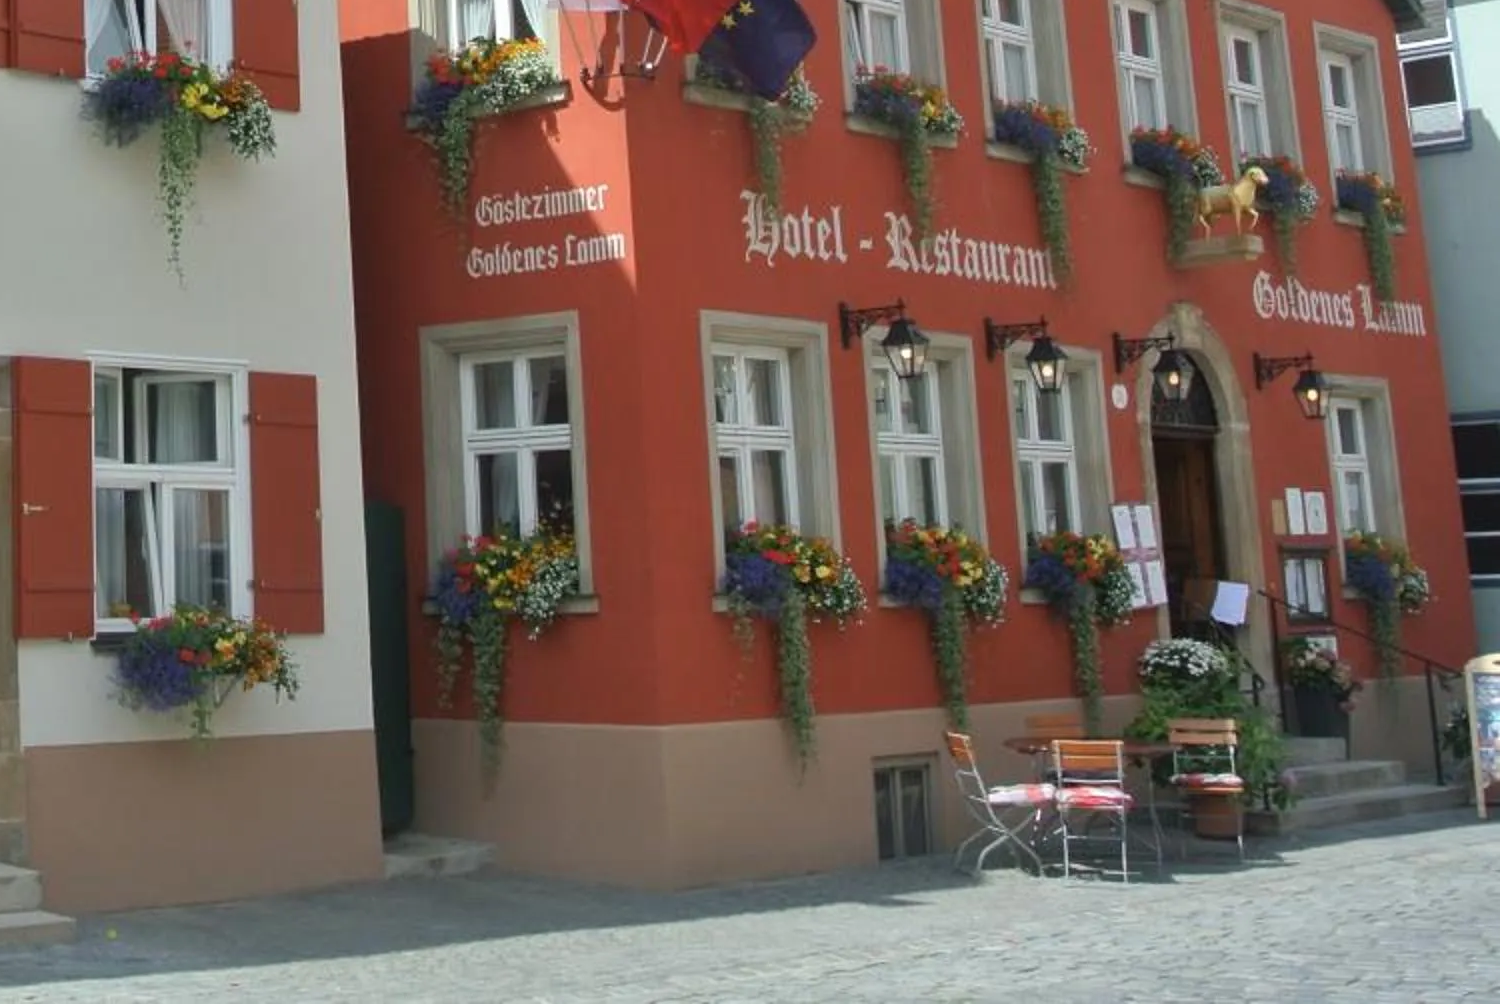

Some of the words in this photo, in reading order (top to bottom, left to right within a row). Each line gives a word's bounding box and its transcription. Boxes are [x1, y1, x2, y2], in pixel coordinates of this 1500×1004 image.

[474, 183, 610, 228] Gästezimmer
[739, 189, 849, 269] Hotel
[465, 240, 560, 280] Goldenes
[564, 231, 627, 267] Lamm
[1252, 269, 1356, 330] Goldenes
